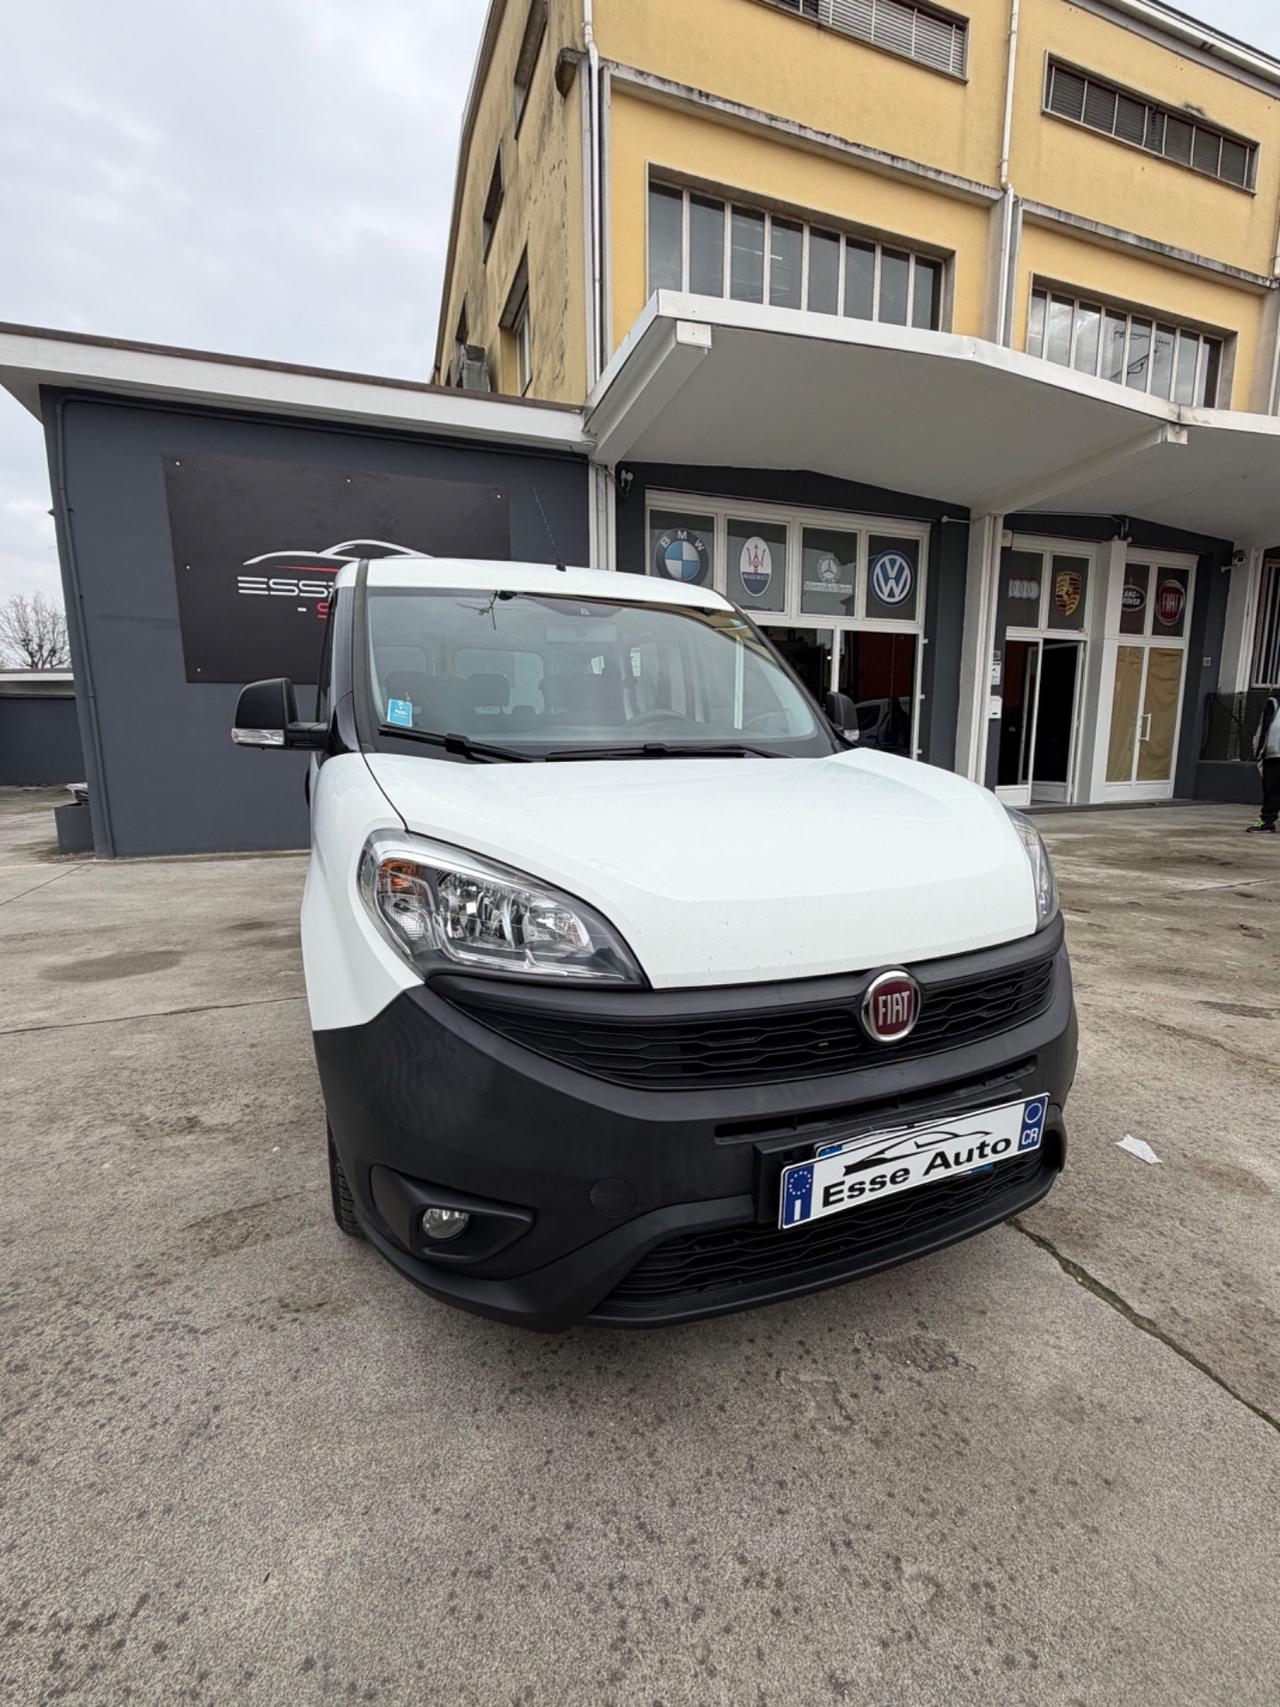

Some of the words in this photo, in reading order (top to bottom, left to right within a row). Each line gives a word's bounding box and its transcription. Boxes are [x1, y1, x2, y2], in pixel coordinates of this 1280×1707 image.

[660, 530, 705, 551] BMW
[237, 576, 334, 598] ESS
[1162, 592, 1180, 614] FIAT
[878, 990, 910, 1027] FIAT
[1021, 1127, 1039, 1146] CR
[822, 1164, 910, 1208] Esse
[923, 1137, 1012, 1177] Auto
